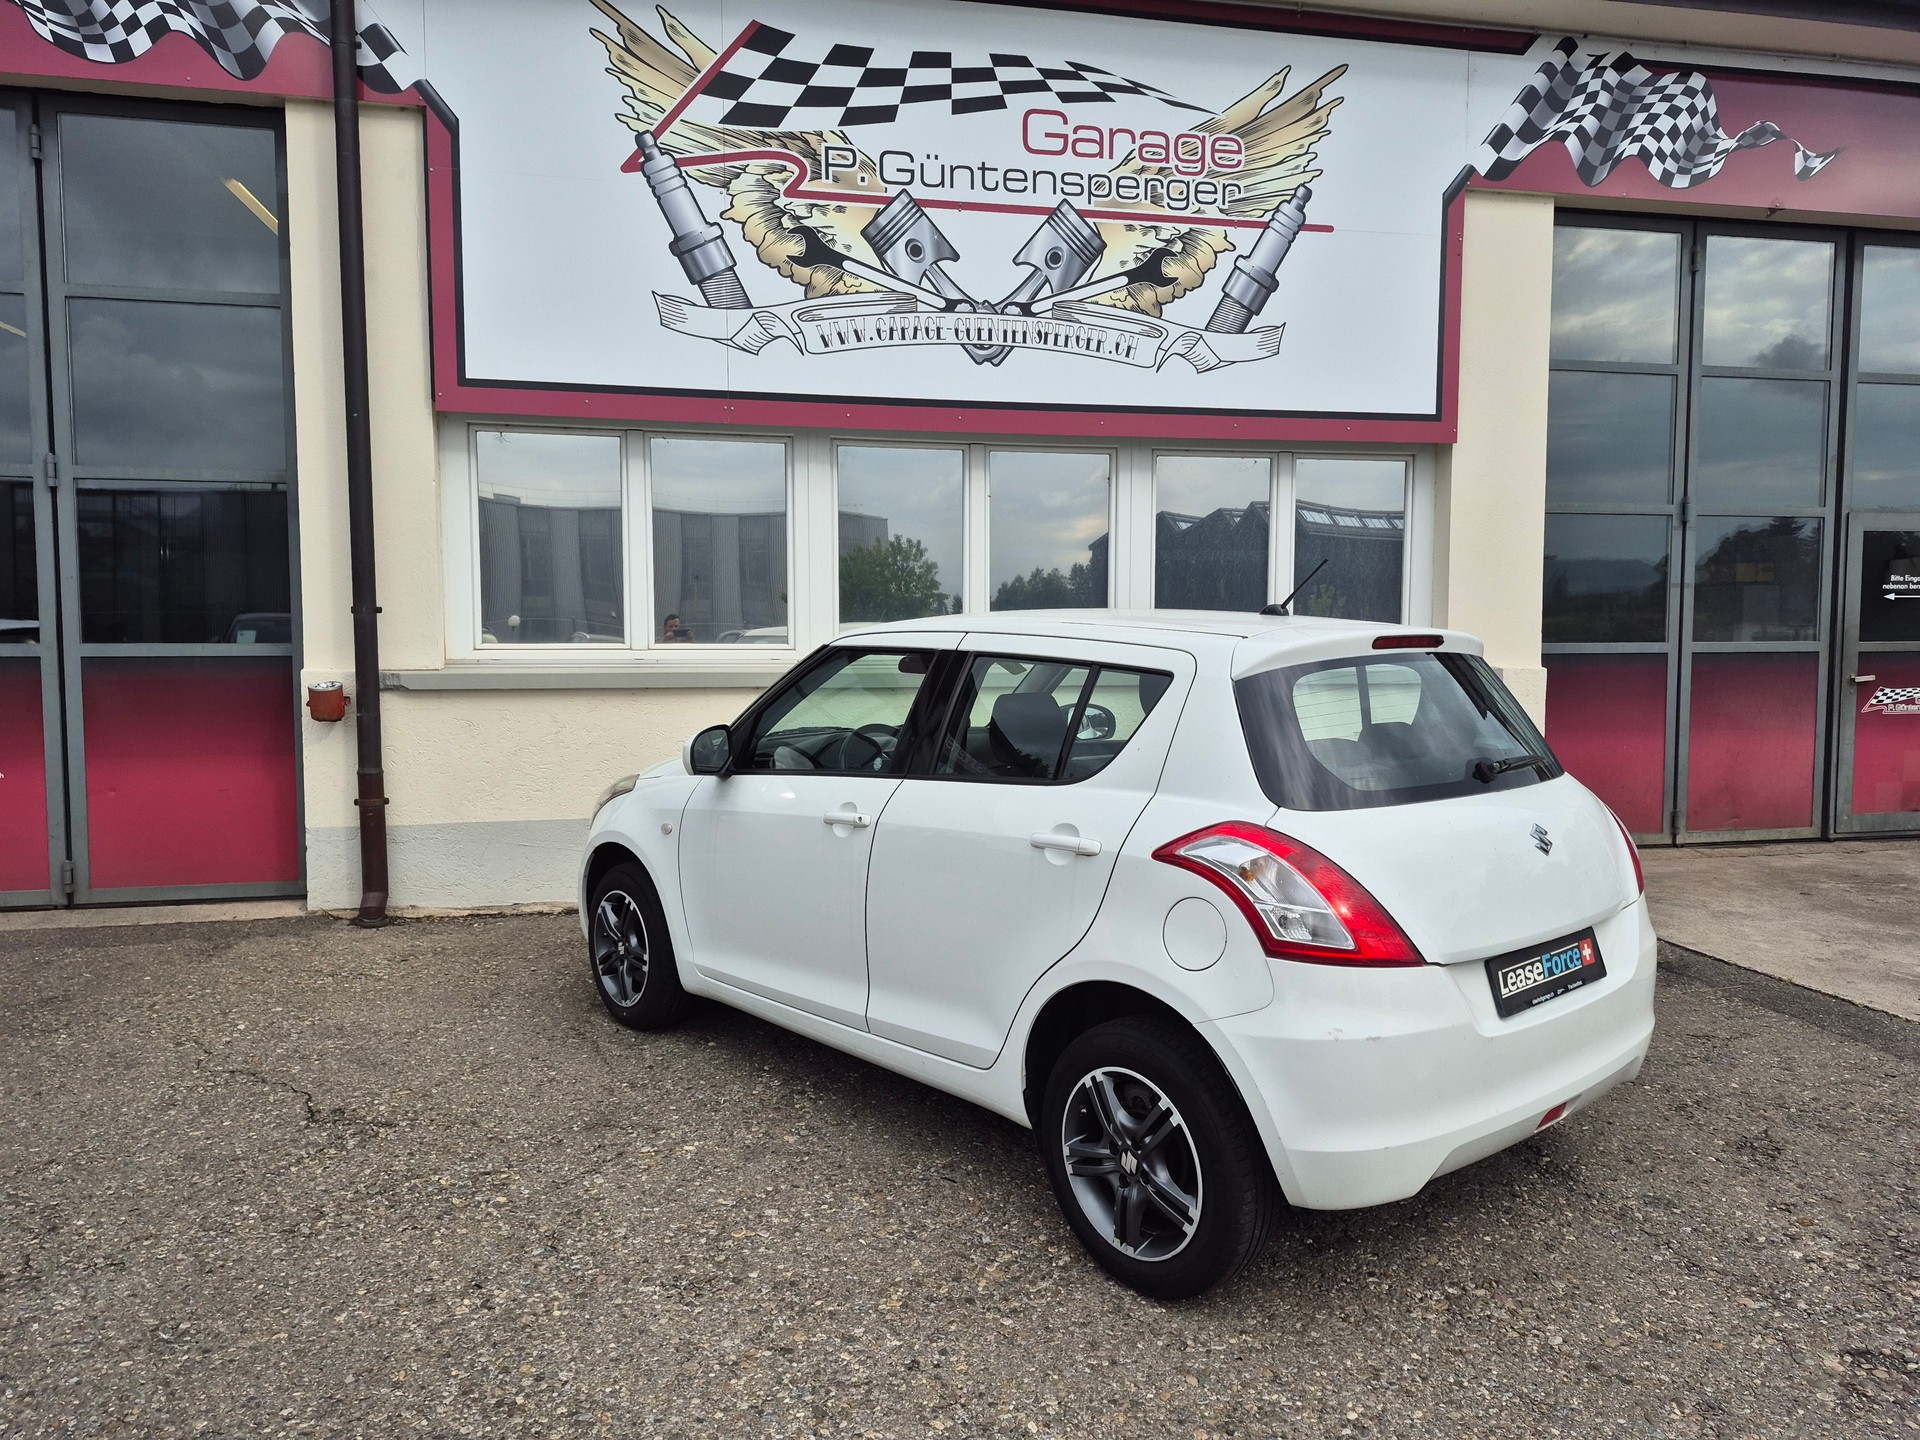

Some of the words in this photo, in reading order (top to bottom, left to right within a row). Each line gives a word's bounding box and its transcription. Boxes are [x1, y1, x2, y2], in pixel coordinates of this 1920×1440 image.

[1022, 108, 1244, 176] Garage
[878, 150, 1243, 211] Güntensperger
[815, 315, 1141, 361] WWW.GARAGE-GUENTENSPERGER.CH
[1498, 946, 1581, 996] LeaseForce
